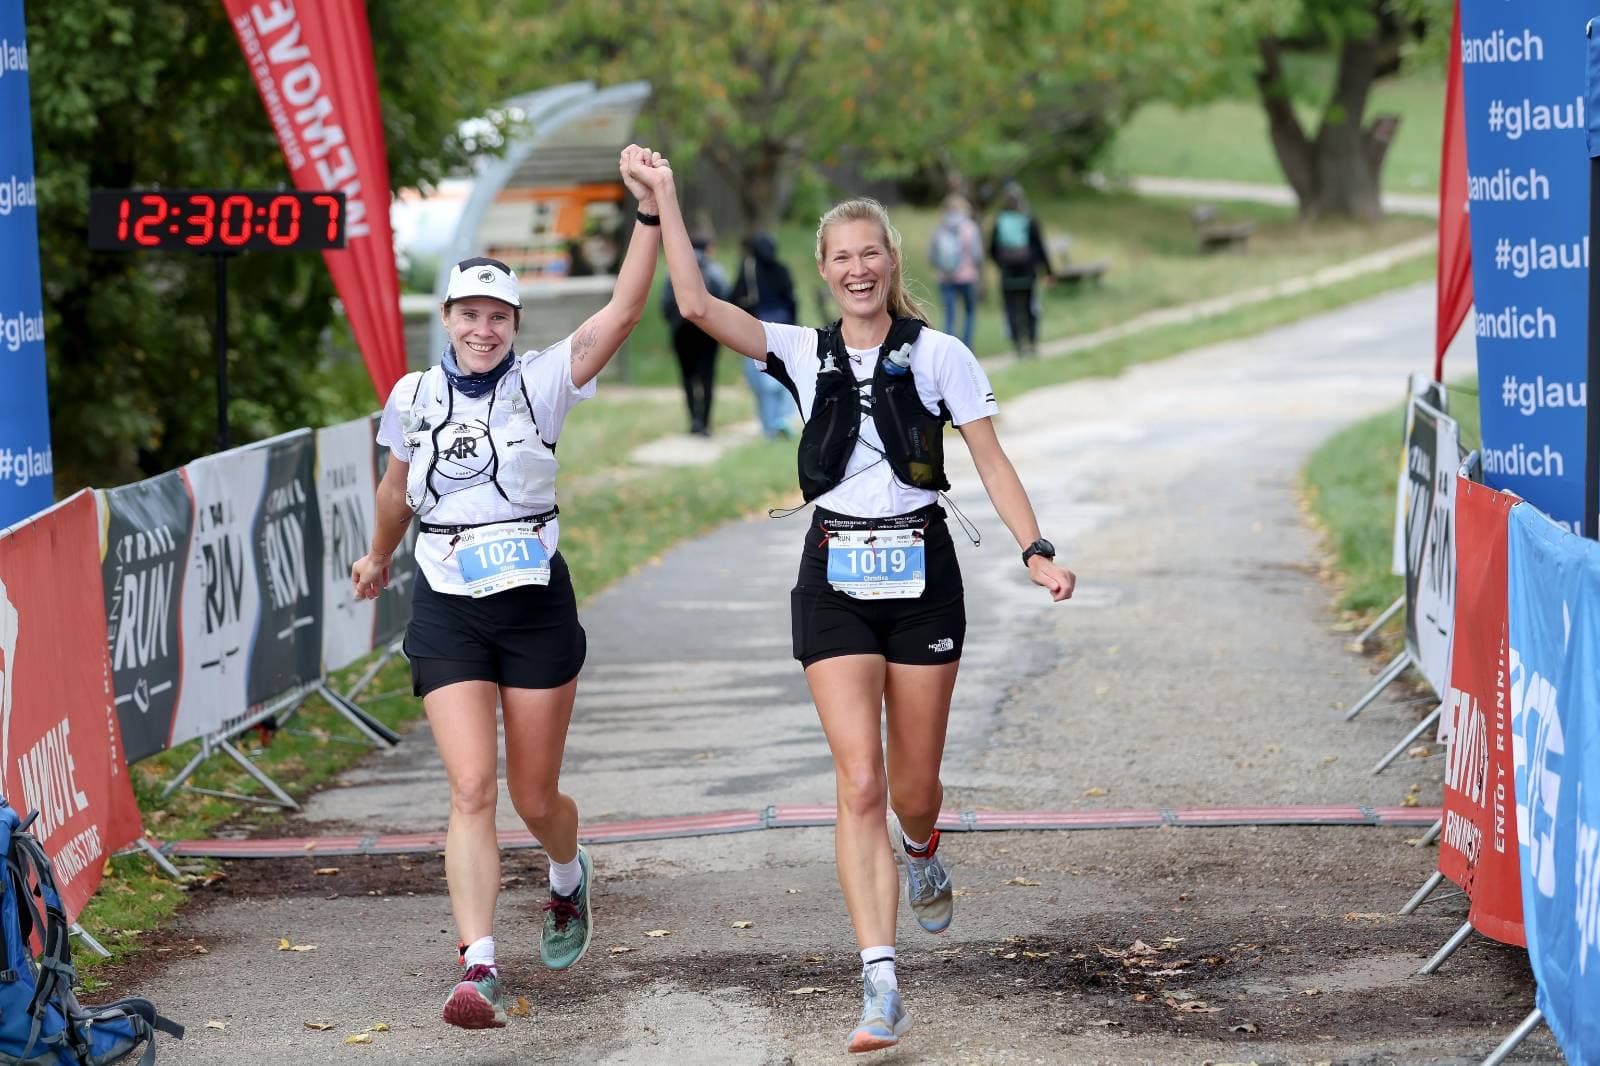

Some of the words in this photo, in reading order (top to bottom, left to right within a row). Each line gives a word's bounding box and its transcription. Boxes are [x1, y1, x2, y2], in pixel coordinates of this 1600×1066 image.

[117, 195, 339, 246] 12:30:07
[474, 539, 530, 569] 1021
[847, 549, 906, 574] 1019
[113, 561, 175, 672] RUN
[1496, 763, 1505, 853] ENJOY
